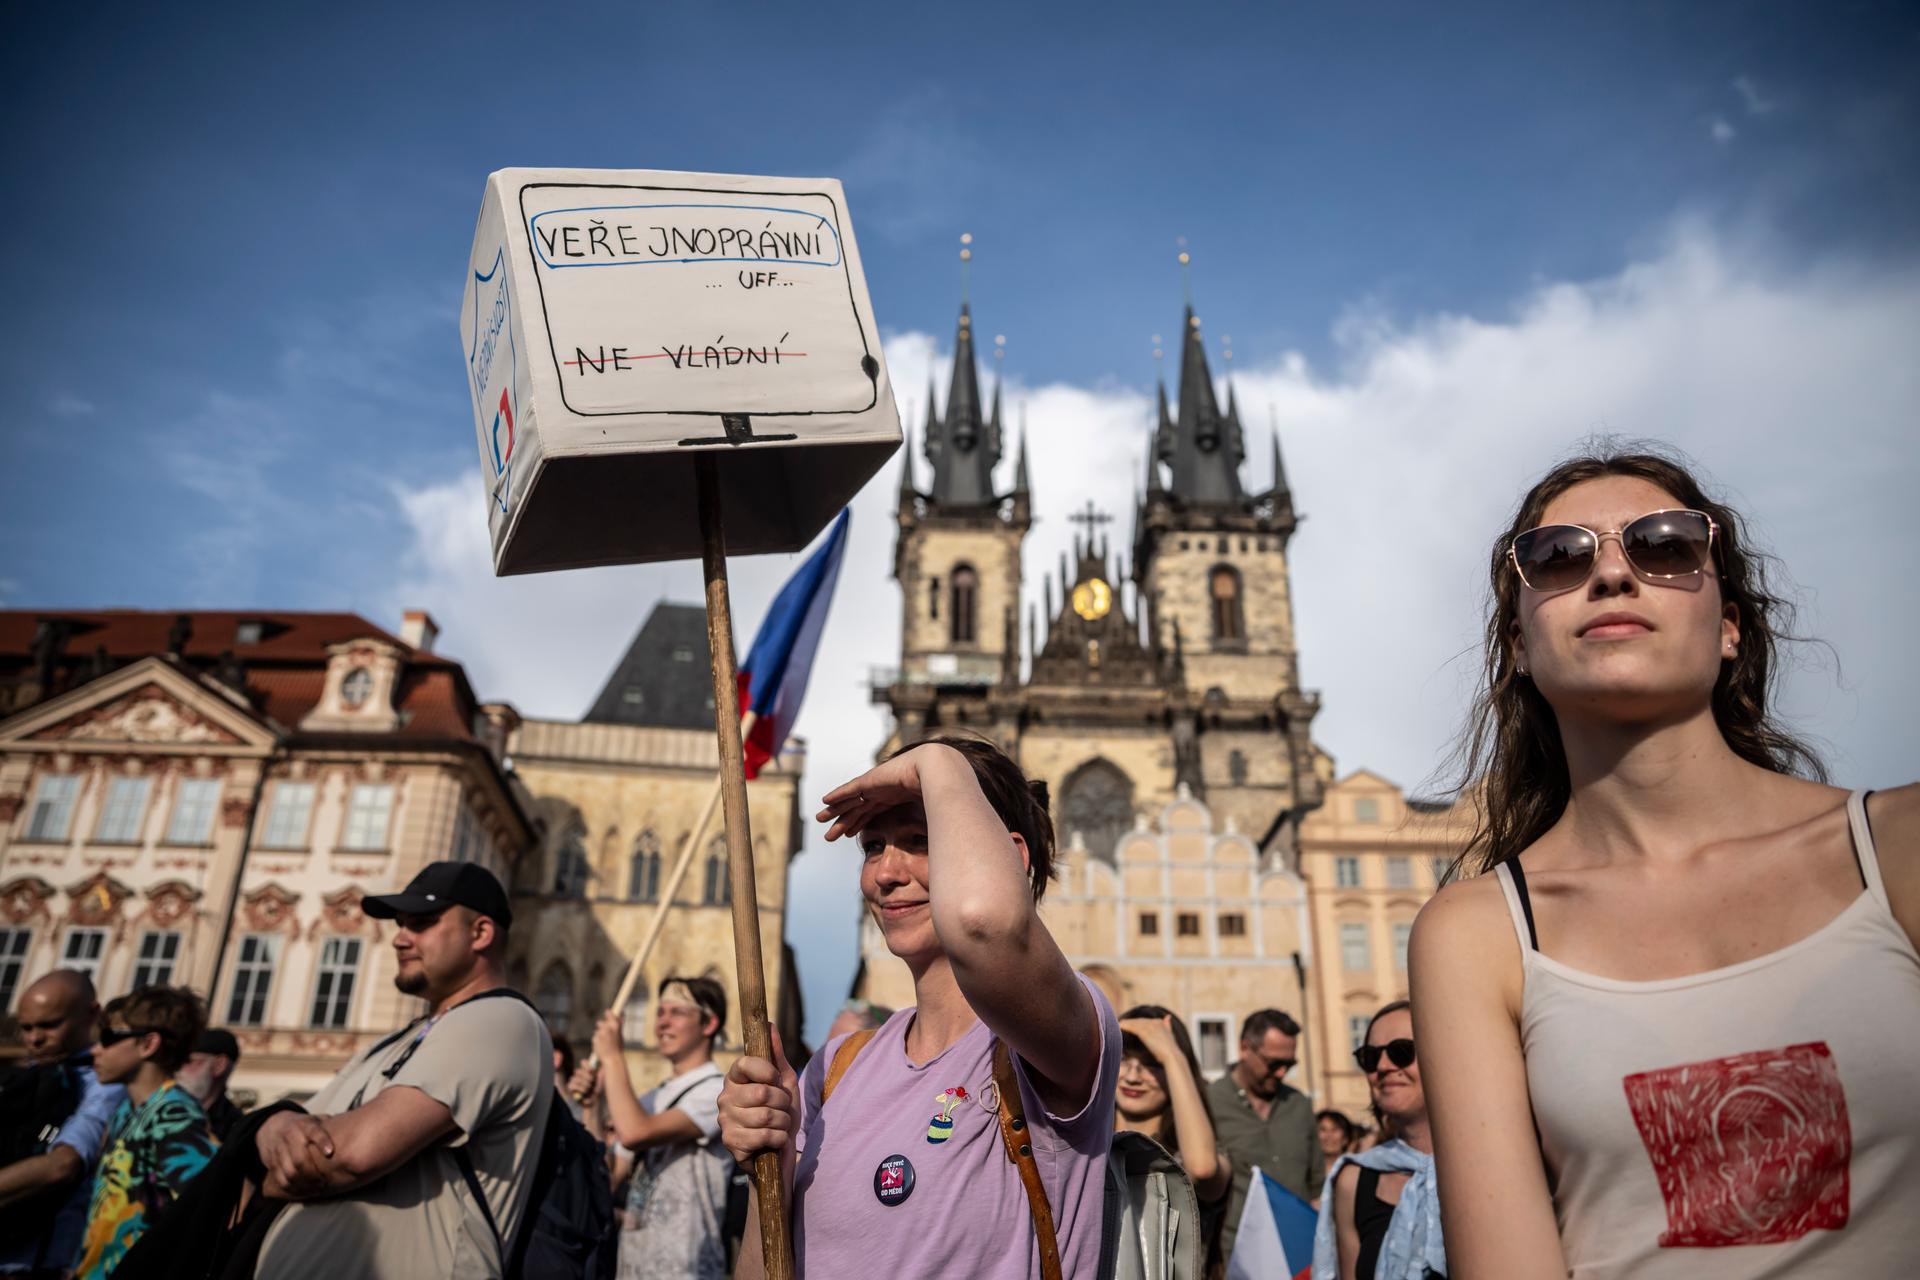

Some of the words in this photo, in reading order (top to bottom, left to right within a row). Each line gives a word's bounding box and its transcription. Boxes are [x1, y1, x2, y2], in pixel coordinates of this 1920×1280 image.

[537, 218, 826, 259] VEŘEJNOPRÁVNÍ
[576, 345, 633, 377] NE
[661, 332, 790, 370] VLÁDNÍ
